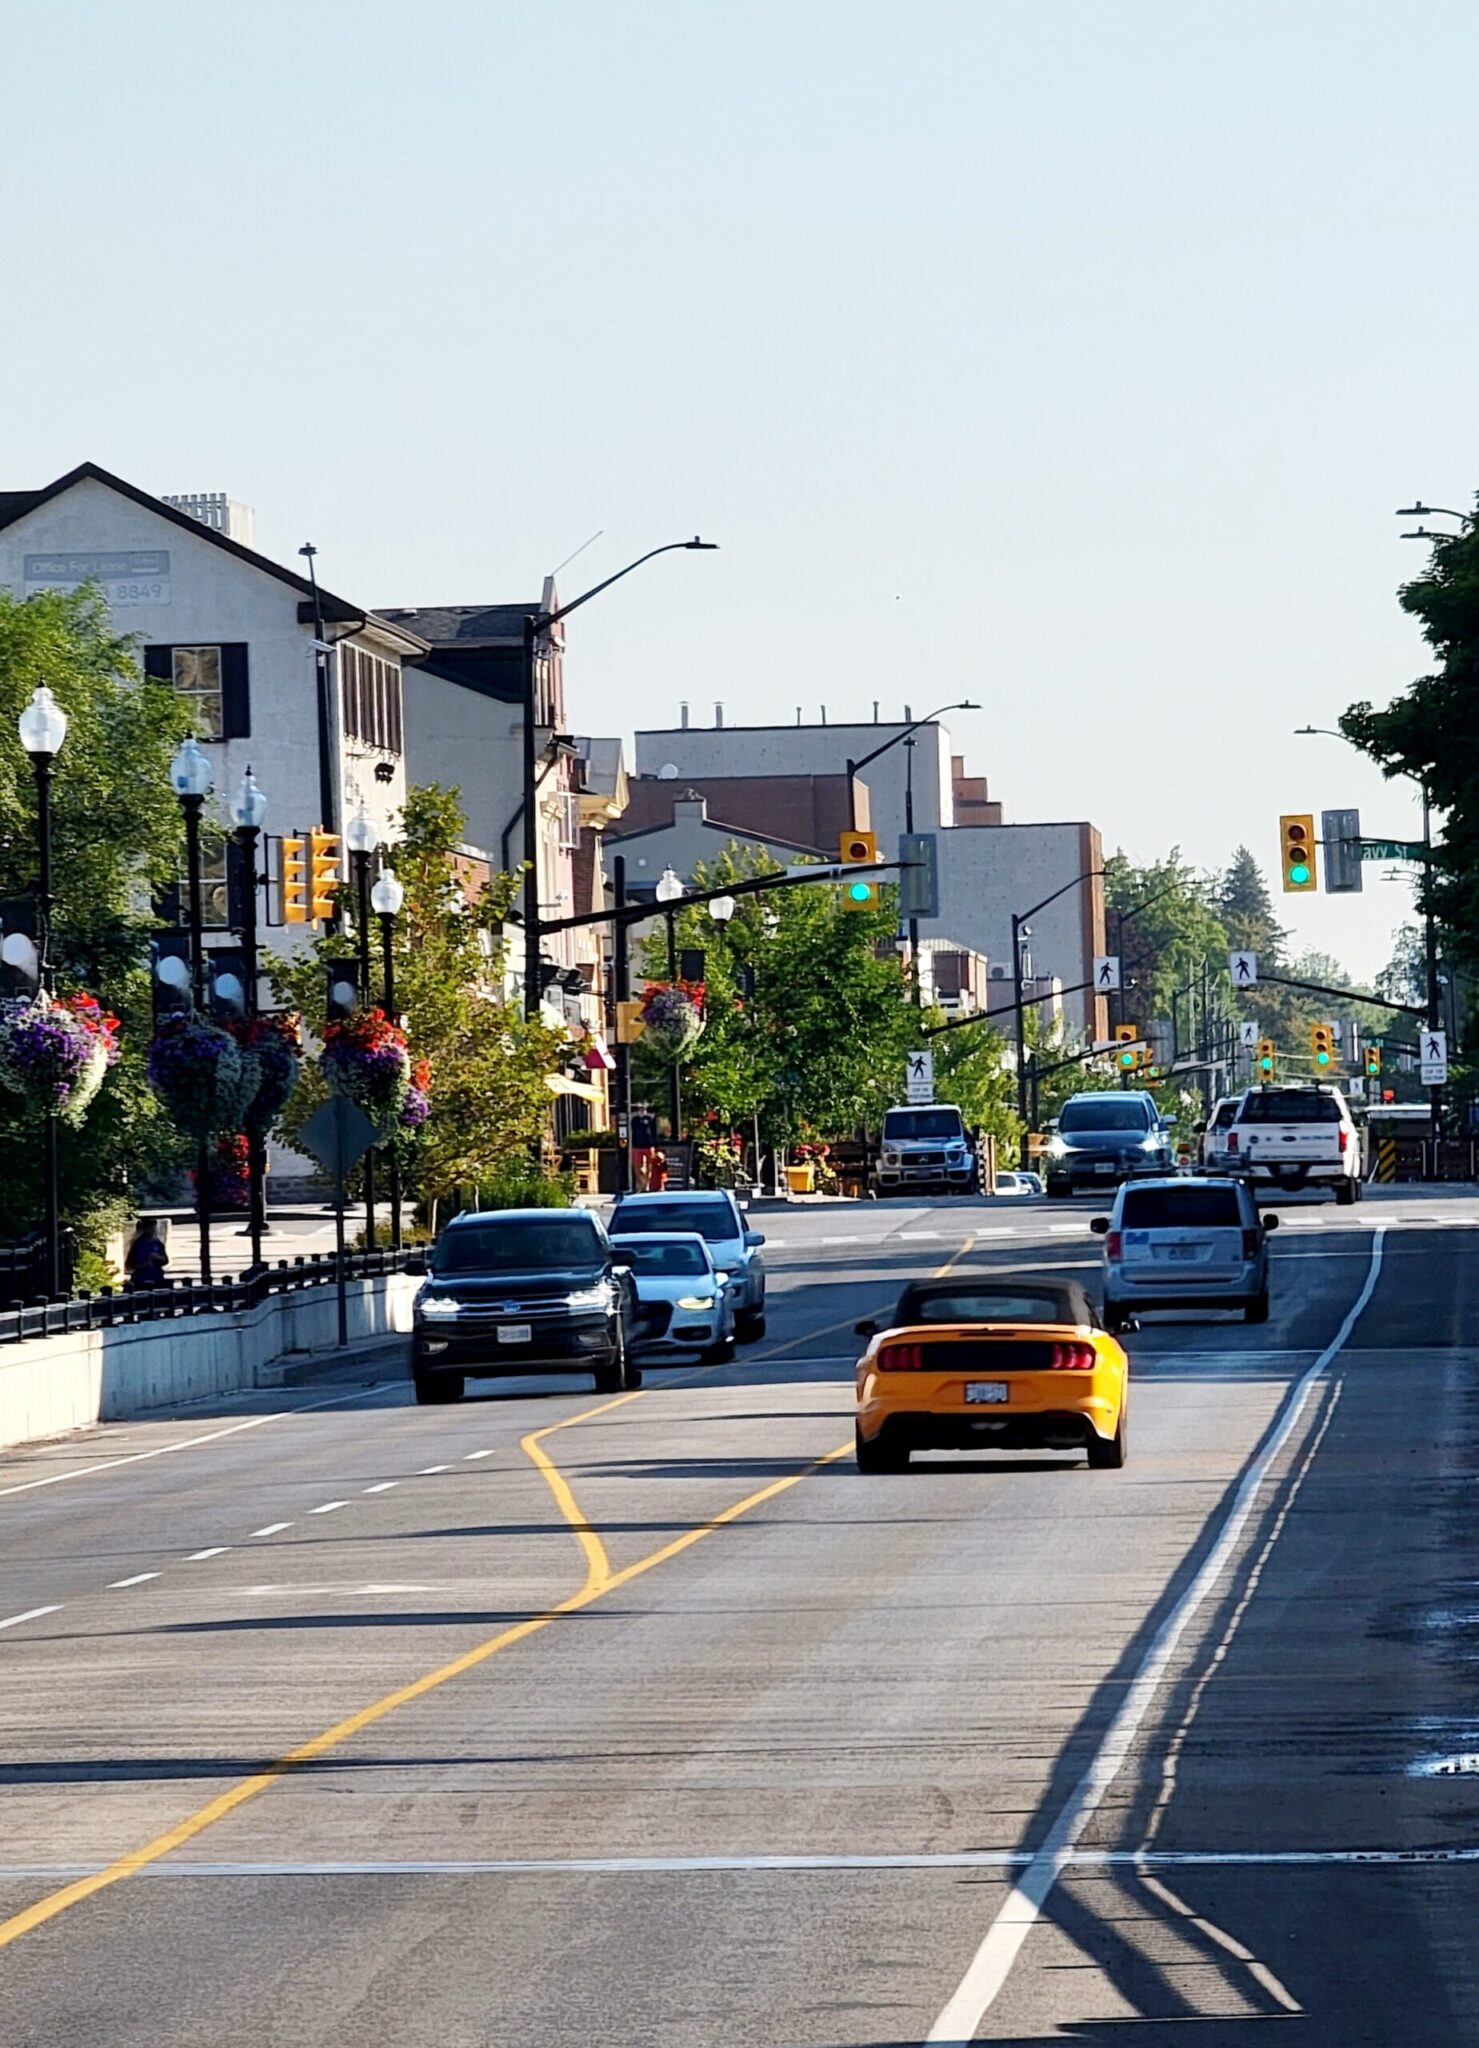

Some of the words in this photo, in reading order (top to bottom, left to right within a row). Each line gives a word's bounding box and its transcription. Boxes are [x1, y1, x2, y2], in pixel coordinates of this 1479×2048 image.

[32, 561, 67, 574] Office
[69, 560, 90, 573] For
[116, 584, 162, 600] 8849
[1363, 845, 1388, 860] avy
[1395, 844, 1408, 860] St
